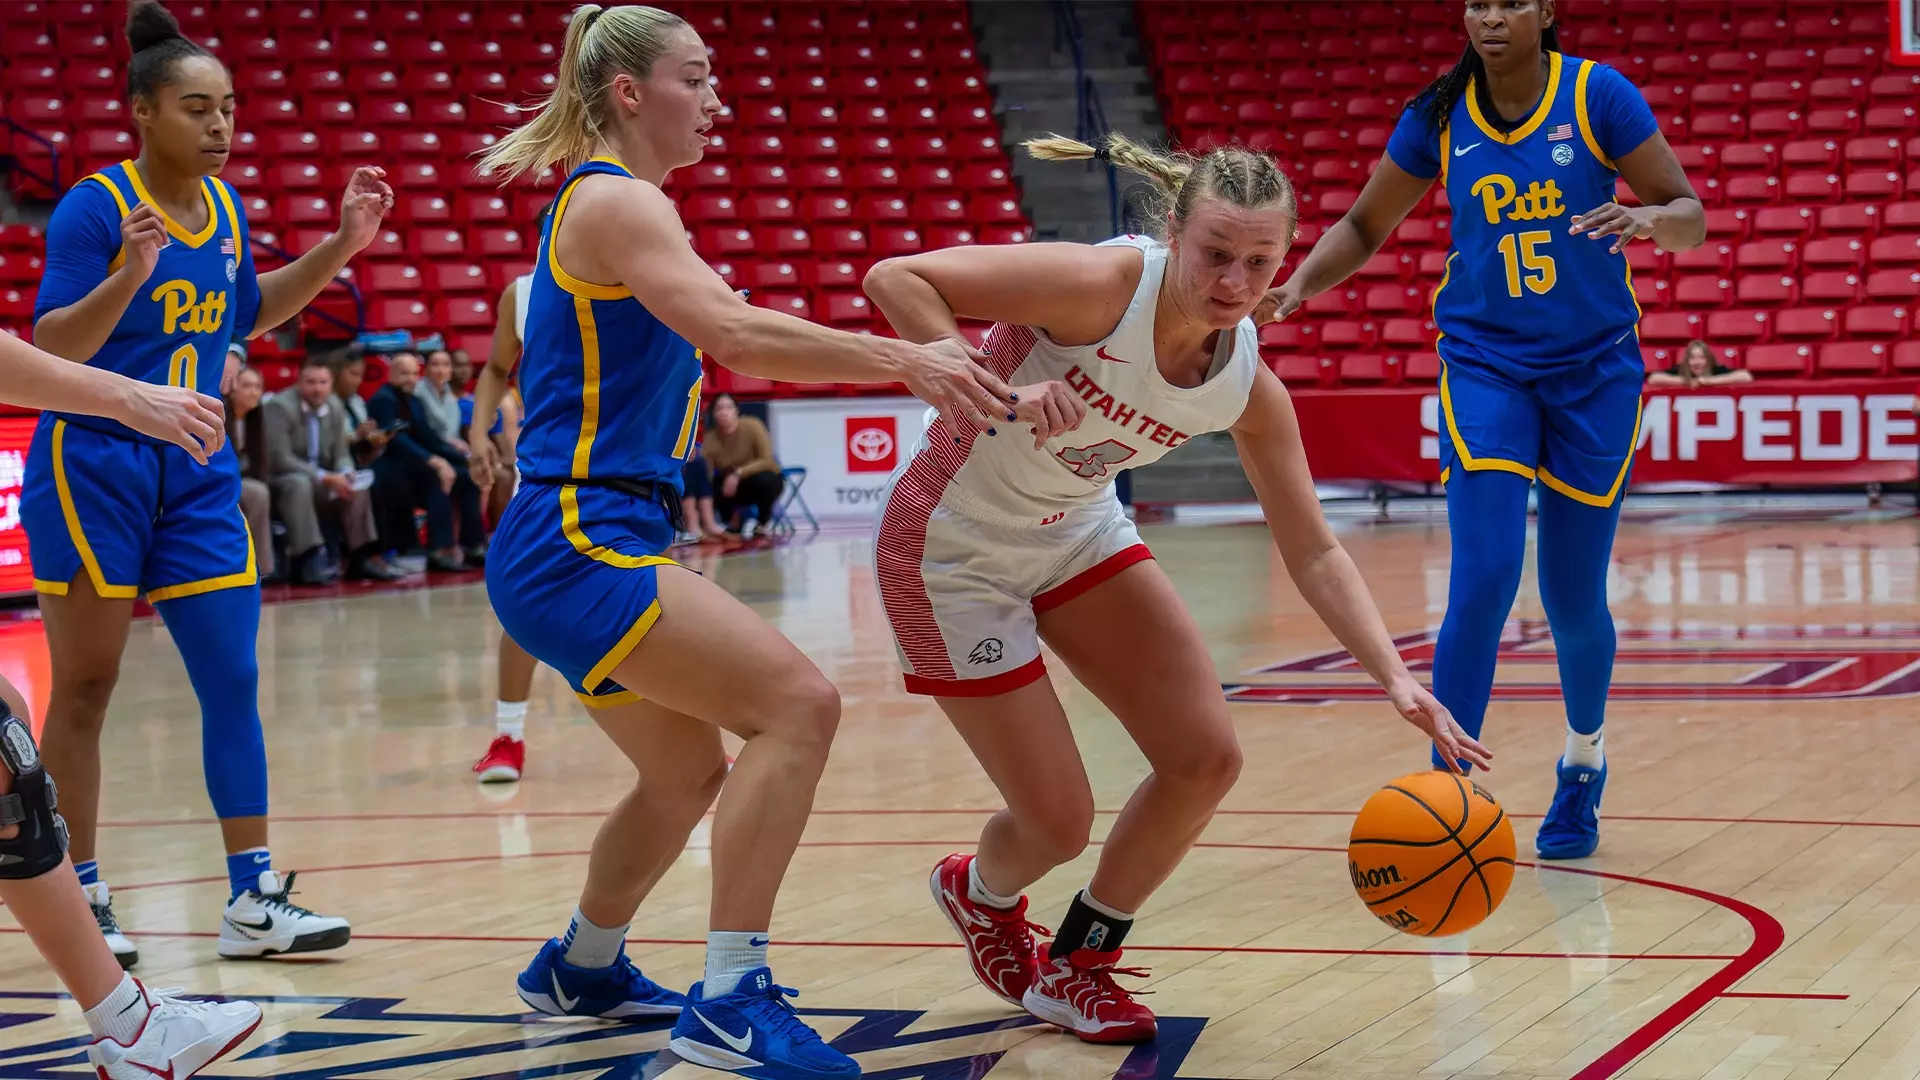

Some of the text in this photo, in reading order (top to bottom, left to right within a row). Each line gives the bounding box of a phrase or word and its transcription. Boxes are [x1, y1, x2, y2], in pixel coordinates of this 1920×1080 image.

[1471, 174, 1566, 224] Pitt
[1498, 230, 1557, 298] 15
[151, 279, 227, 334] Pitt
[1065, 365, 1192, 447] UTAH TEC
[1420, 394, 1919, 461] MPEDE
[1349, 860, 1402, 889] lson
